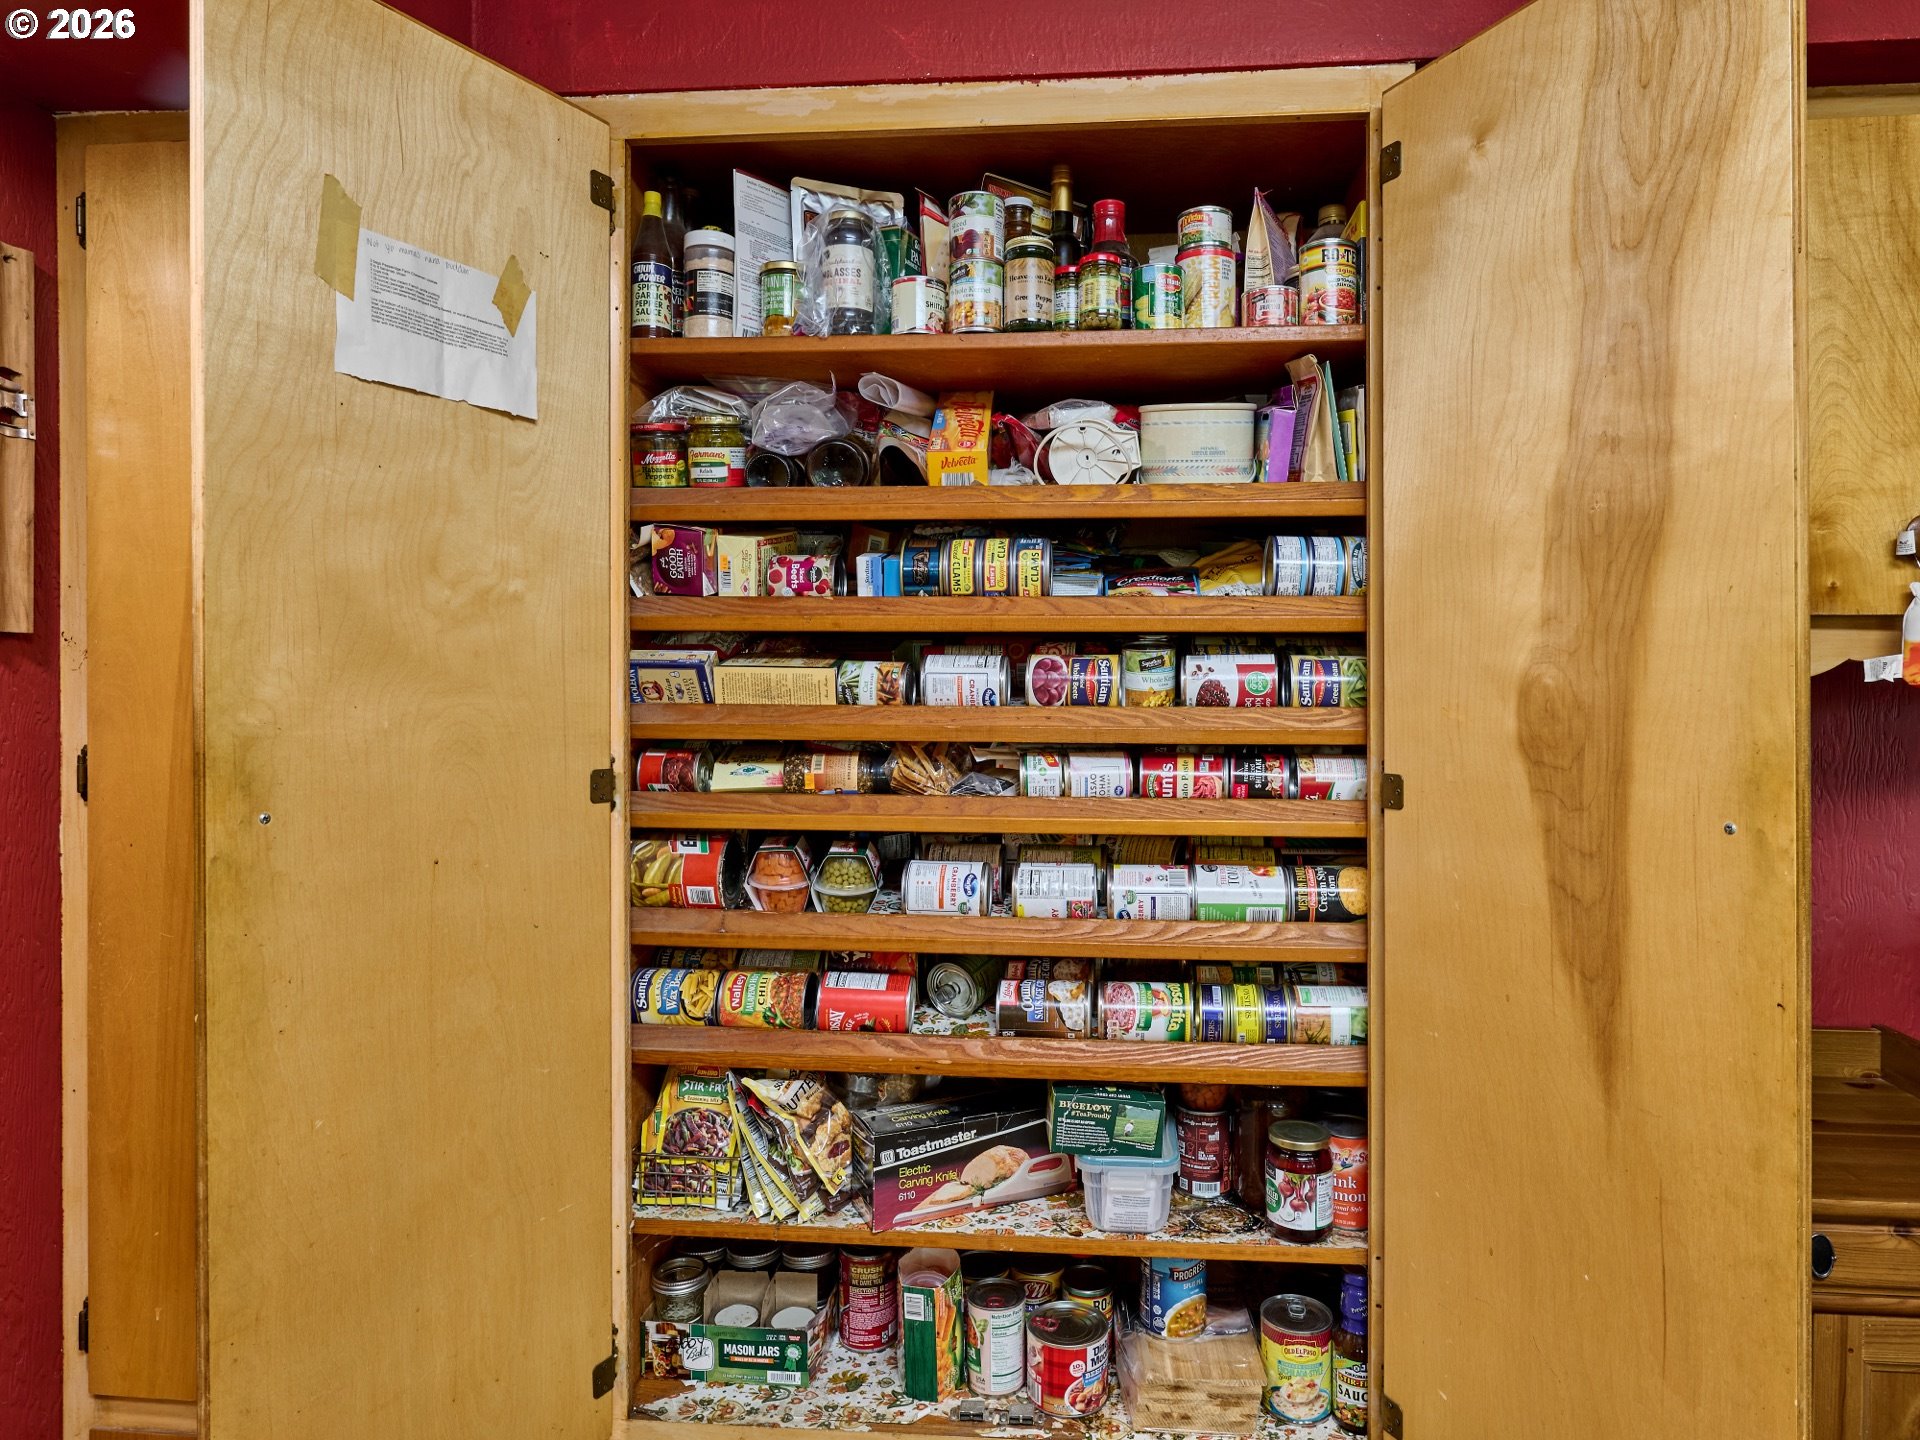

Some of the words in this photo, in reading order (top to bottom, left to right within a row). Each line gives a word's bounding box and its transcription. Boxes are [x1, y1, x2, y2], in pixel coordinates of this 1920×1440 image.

[638, 274, 666, 284] POWER
[635, 300, 663, 308] PEPPER
[1014, 294, 1033, 302] Gree
[636, 308, 662, 316] SAUCE
[954, 401, 986, 439] Velveeta
[640, 453, 677, 465] Mezzetta
[689, 450, 726, 461] Farman's
[940, 456, 977, 470] Velveeta
[641, 466, 677, 475] Habanero
[645, 472, 675, 481] Peppers
[997, 539, 1006, 559] CLAM
[668, 547, 677, 579] GOOD
[676, 548, 684, 579] EARTH
[1031, 552, 1039, 583] CLAMS
[791, 563, 800, 589] Beets
[953, 561, 961, 592] CLAMS
[997, 560, 1005, 588] Chopped
[1116, 574, 1185, 587] Creations
[1072, 662, 1080, 681] Whole
[1098, 659, 1110, 703] Santiam
[1072, 681, 1080, 700] Beets
[1300, 661, 1312, 706] Santiam
[1331, 683, 1339, 704] Green
[949, 866, 959, 907] CRANBERRY
[1328, 875, 1336, 897] Corn
[1298, 887, 1307, 912] WESTERN
[1318, 885, 1328, 912] Cream
[666, 989, 678, 1011] Wax
[731, 975, 746, 1008] Nalley
[758, 977, 768, 1006] CHILI
[1035, 989, 1045, 1020] SAUSAGE
[1274, 995, 1282, 1029] OYSTERS
[682, 1080, 728, 1093] STIR-FRY
[926, 1108, 950, 1118] Knife
[1059, 1101, 1112, 1112] BIGELOW
[1071, 1111, 1111, 1120] #TeaProudly
[896, 1129, 978, 1160] Toastmaster
[898, 1176, 933, 1191] Carving
[935, 1169, 958, 1182] Knife
[899, 1163, 931, 1178] Electric
[1334, 1174, 1357, 1189] ink
[898, 1191, 916, 1201] 6110
[1334, 1192, 1366, 1203] mon
[851, 1266, 883, 1274] CRUSH
[724, 1344, 755, 1356] MASON
[757, 1346, 780, 1357] JARS
[1284, 1347, 1295, 1355] OLD
